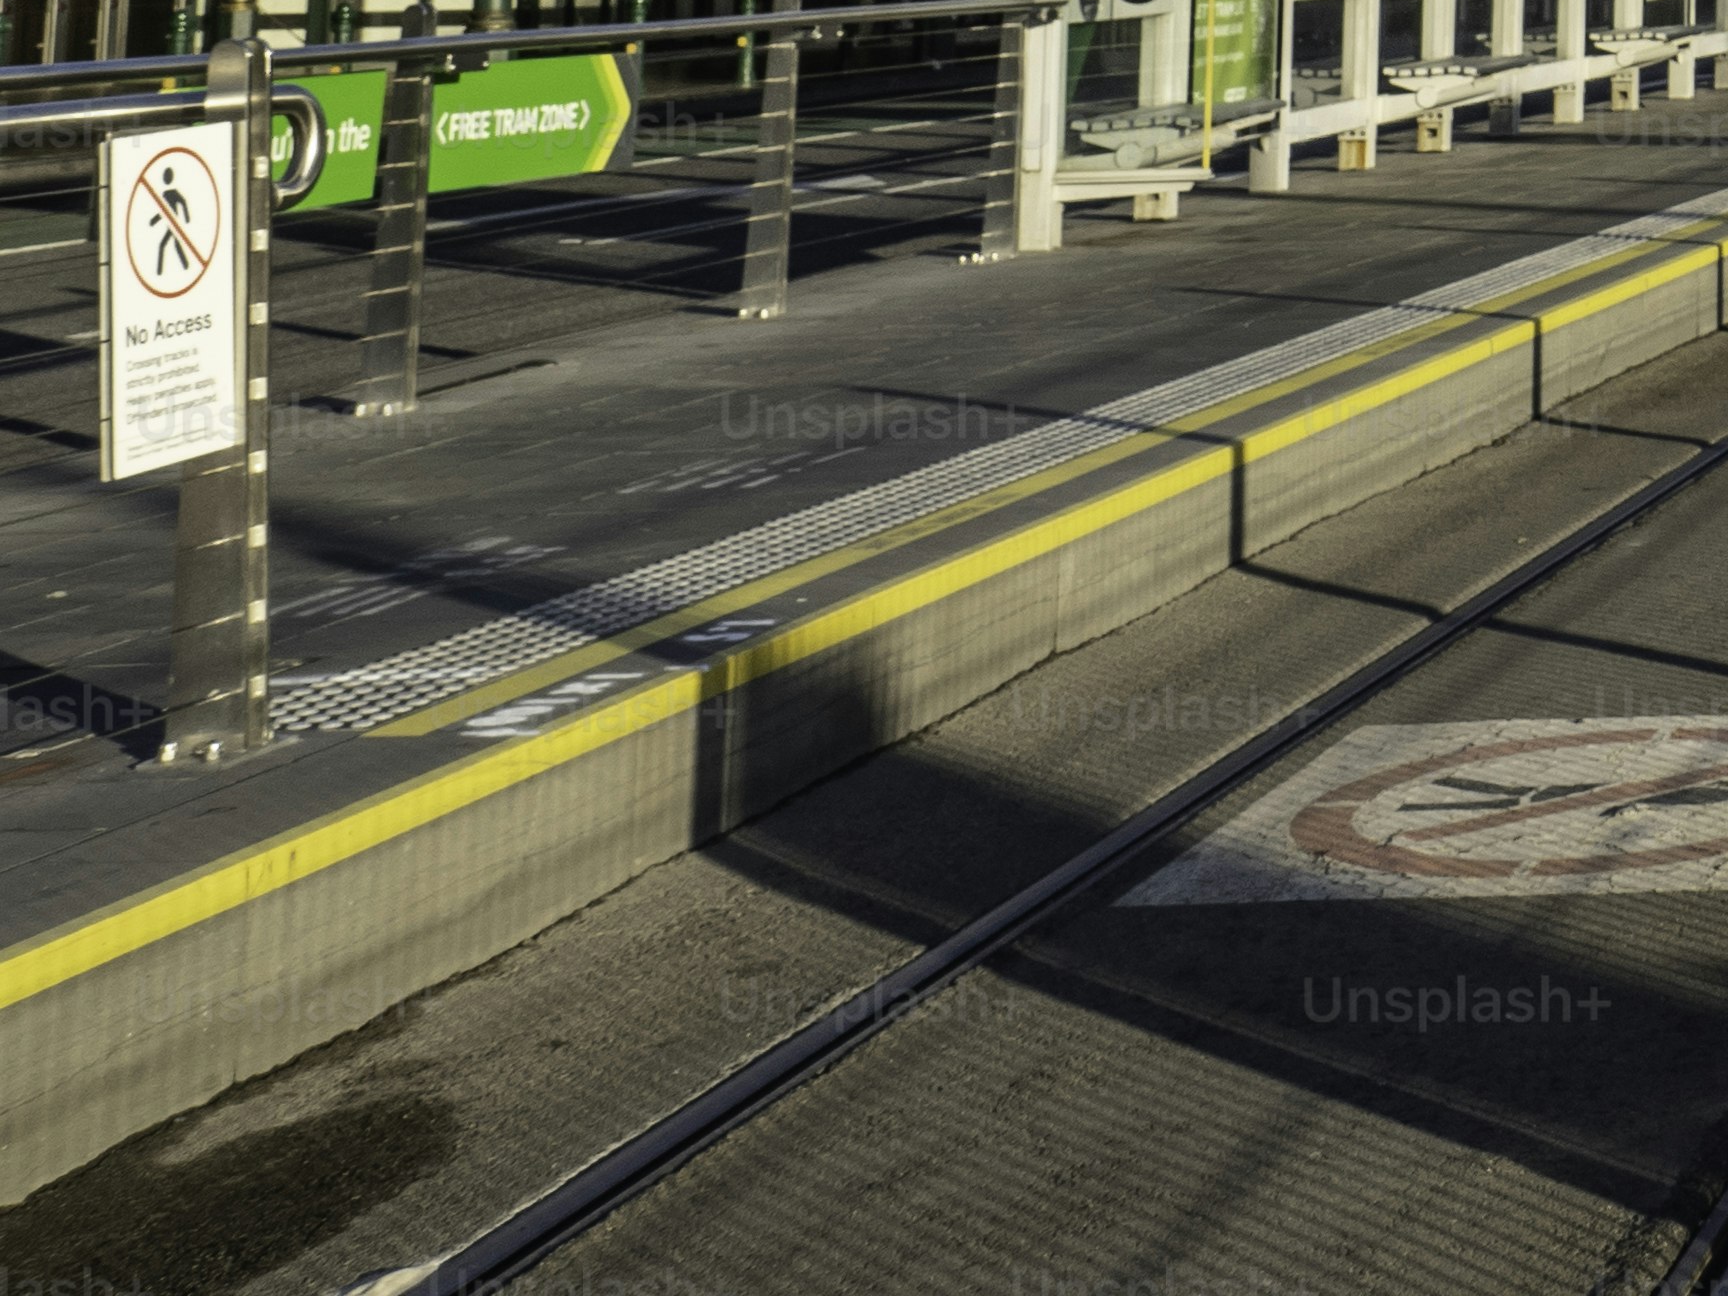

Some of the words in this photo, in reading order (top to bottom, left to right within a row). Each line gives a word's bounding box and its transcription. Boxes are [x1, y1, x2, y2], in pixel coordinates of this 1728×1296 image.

[338, 117, 371, 153] the
[448, 110, 492, 143] FREE
[493, 106, 538, 138] TRAM
[539, 100, 580, 134] ZONE
[125, 325, 149, 348] No
[153, 313, 213, 341] Access
